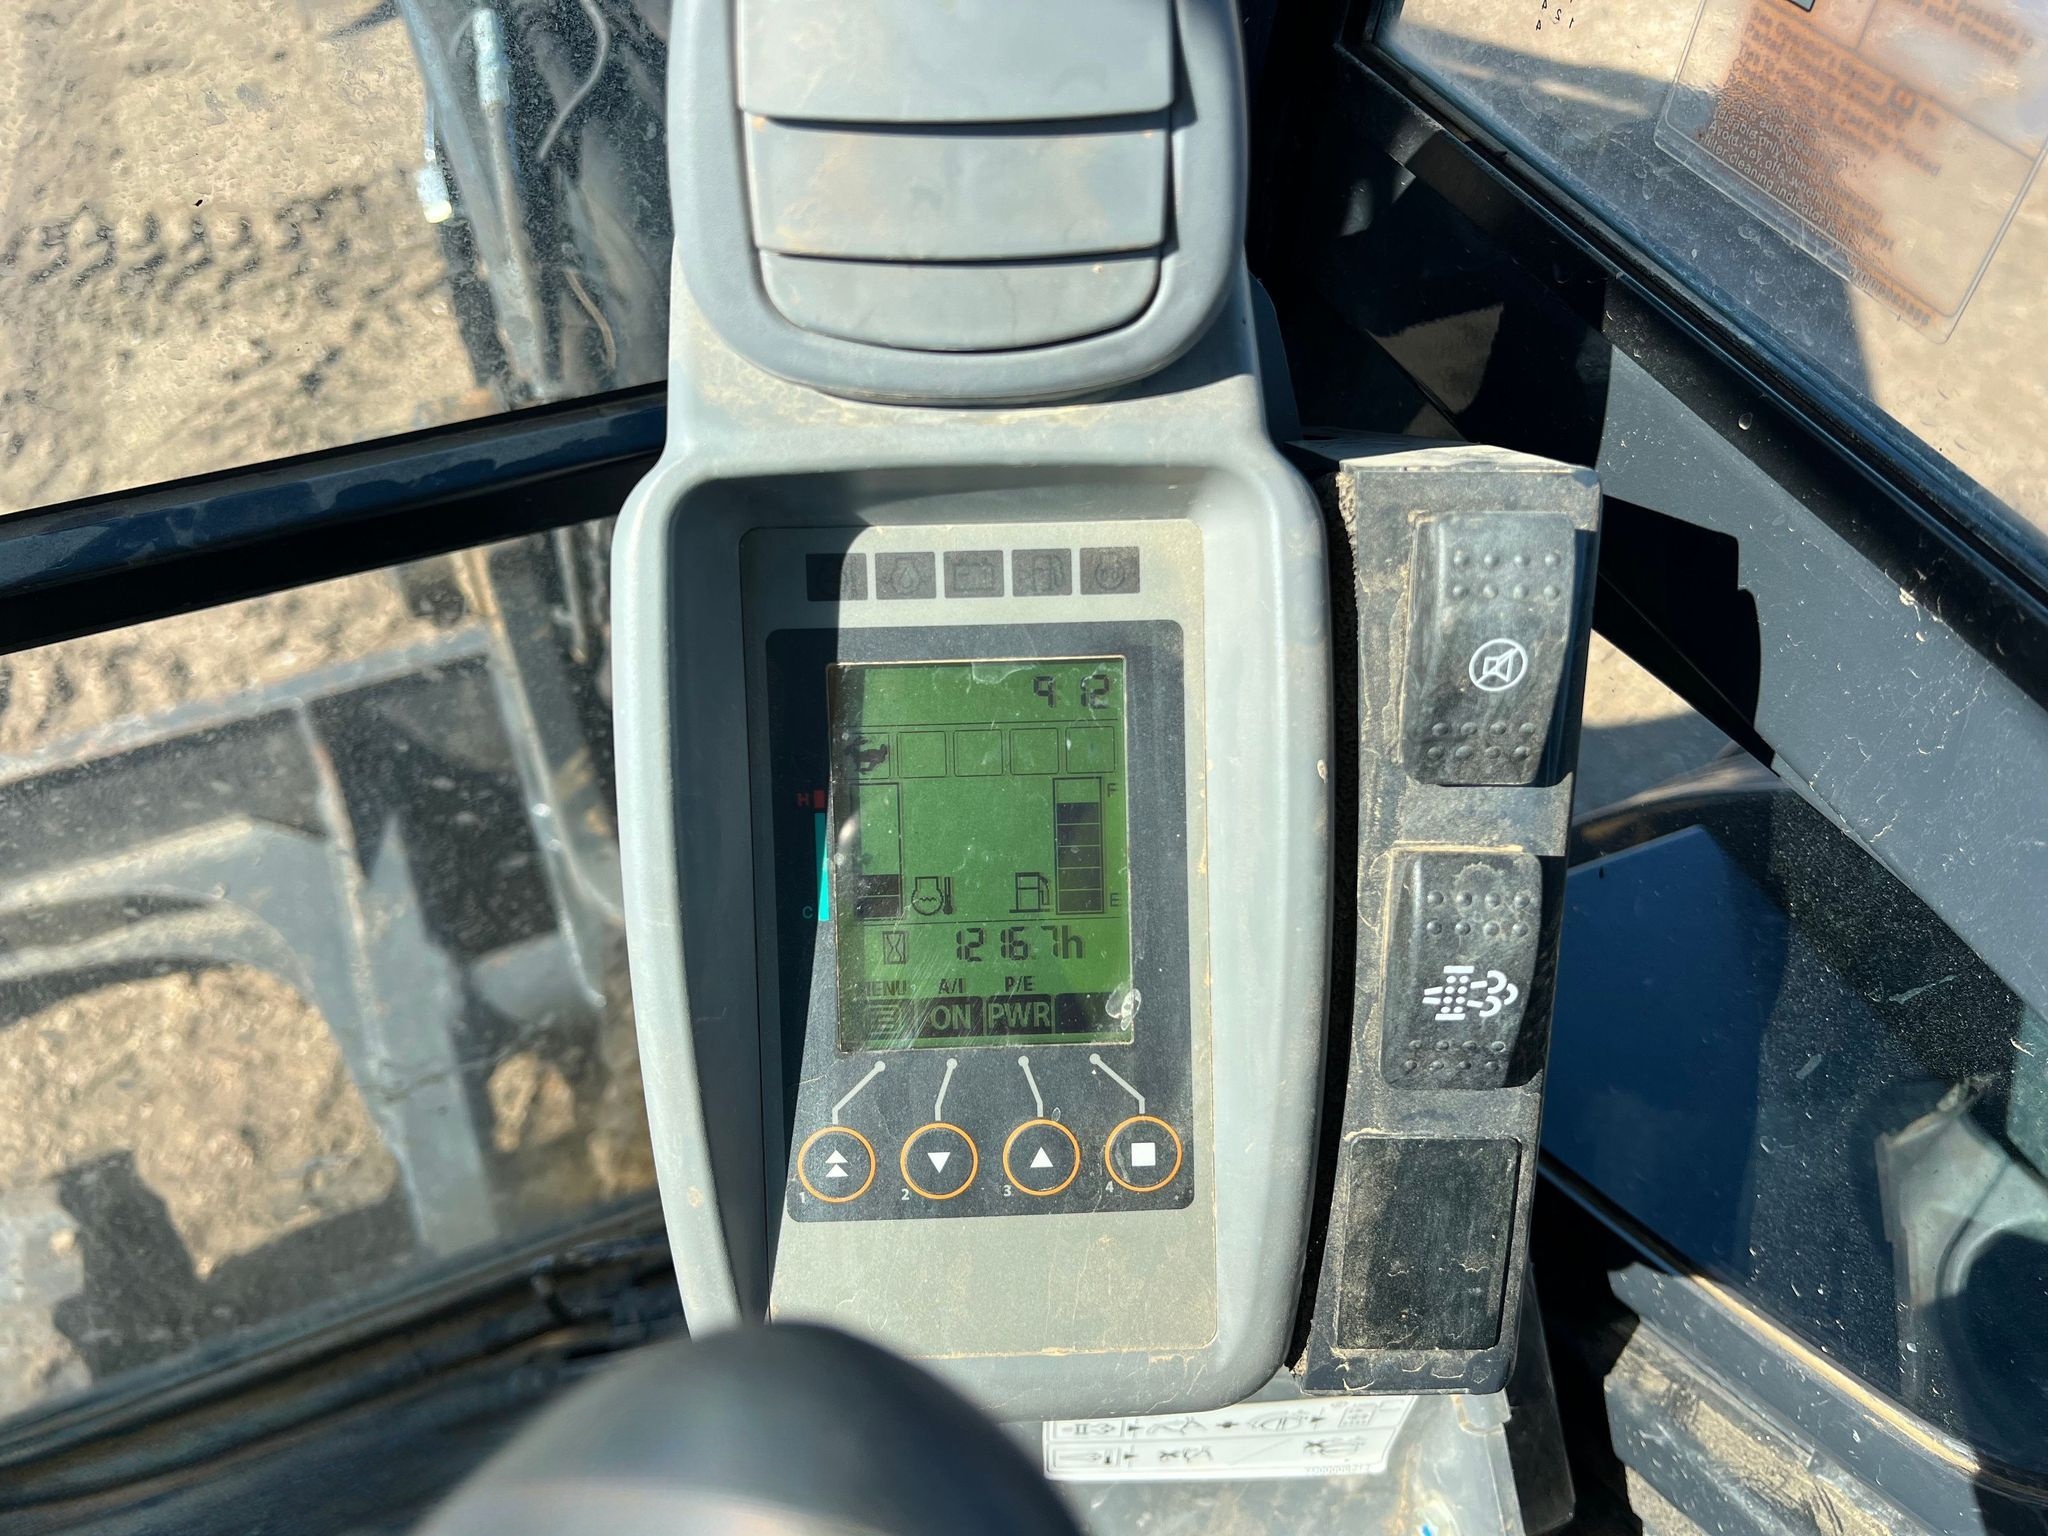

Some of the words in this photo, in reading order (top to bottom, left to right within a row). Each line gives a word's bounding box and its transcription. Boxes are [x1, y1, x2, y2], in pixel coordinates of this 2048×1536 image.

[1107, 783, 1118, 798] F
[1110, 893, 1121, 907] E
[802, 906, 814, 919] C
[938, 978, 965, 994] A/I
[1005, 976, 1033, 992] P/E
[930, 1003, 972, 1031] ON
[988, 1001, 1051, 1029] PWR
[1003, 1185, 1012, 1197] 3
[1105, 1181, 1114, 1193] 4
[798, 1192, 807, 1204] 1
[901, 1189, 910, 1201] 2
